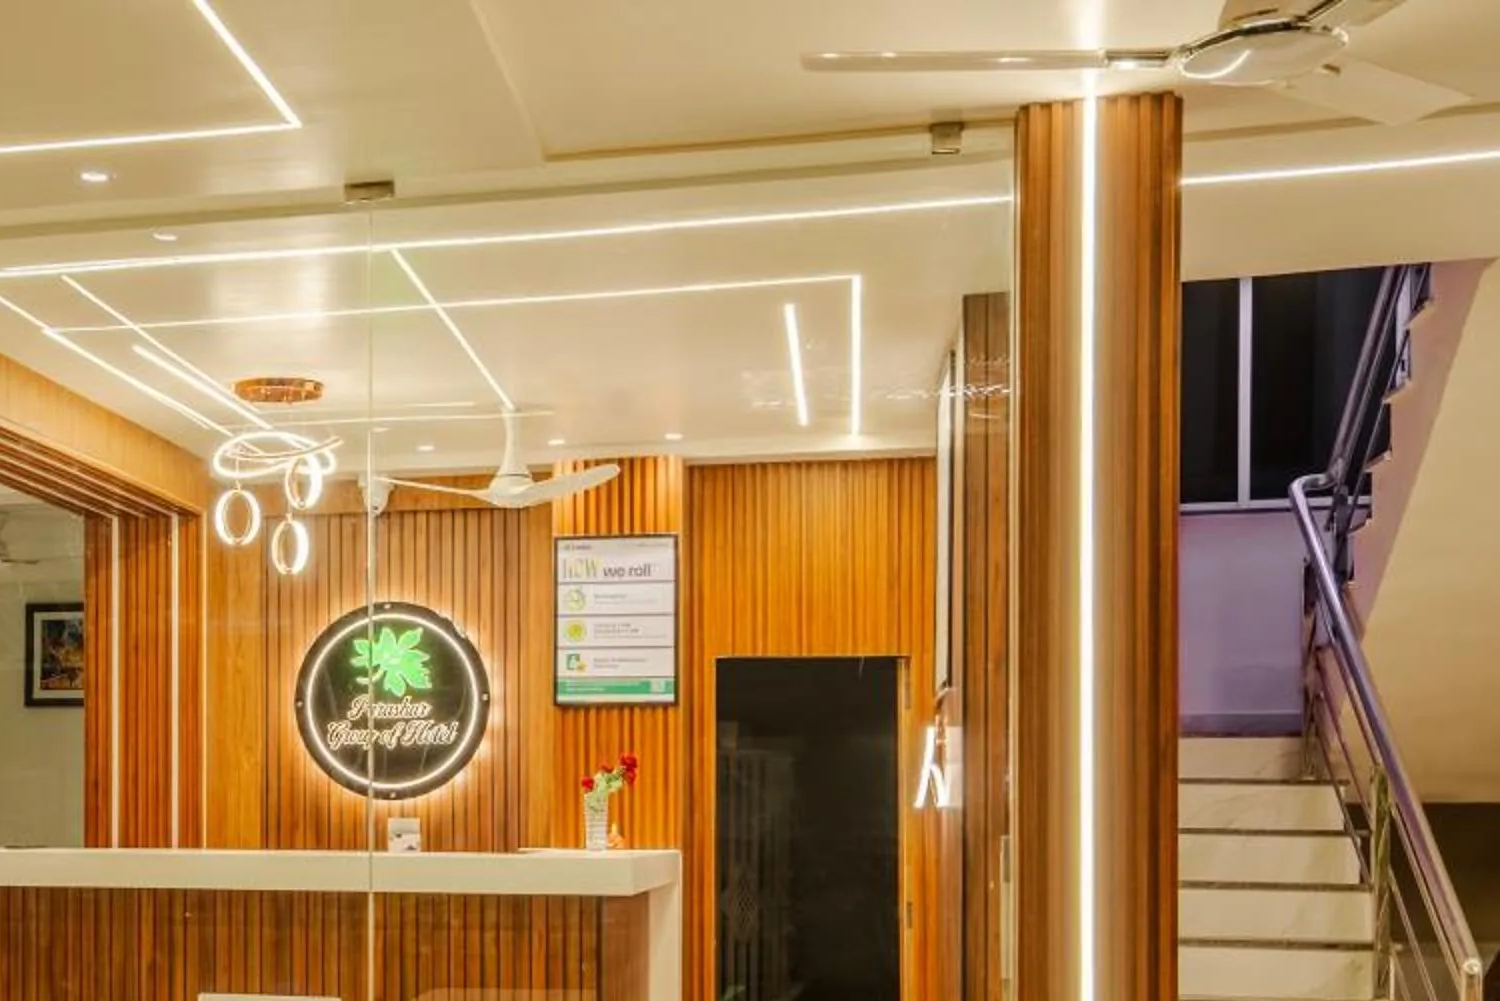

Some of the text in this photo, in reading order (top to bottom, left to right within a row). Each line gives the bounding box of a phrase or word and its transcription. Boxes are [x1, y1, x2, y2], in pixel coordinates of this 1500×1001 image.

[603, 567, 626, 577] we
[628, 563, 651, 577] roll
[379, 721, 406, 750] of
[400, 719, 459, 746] Hotel
